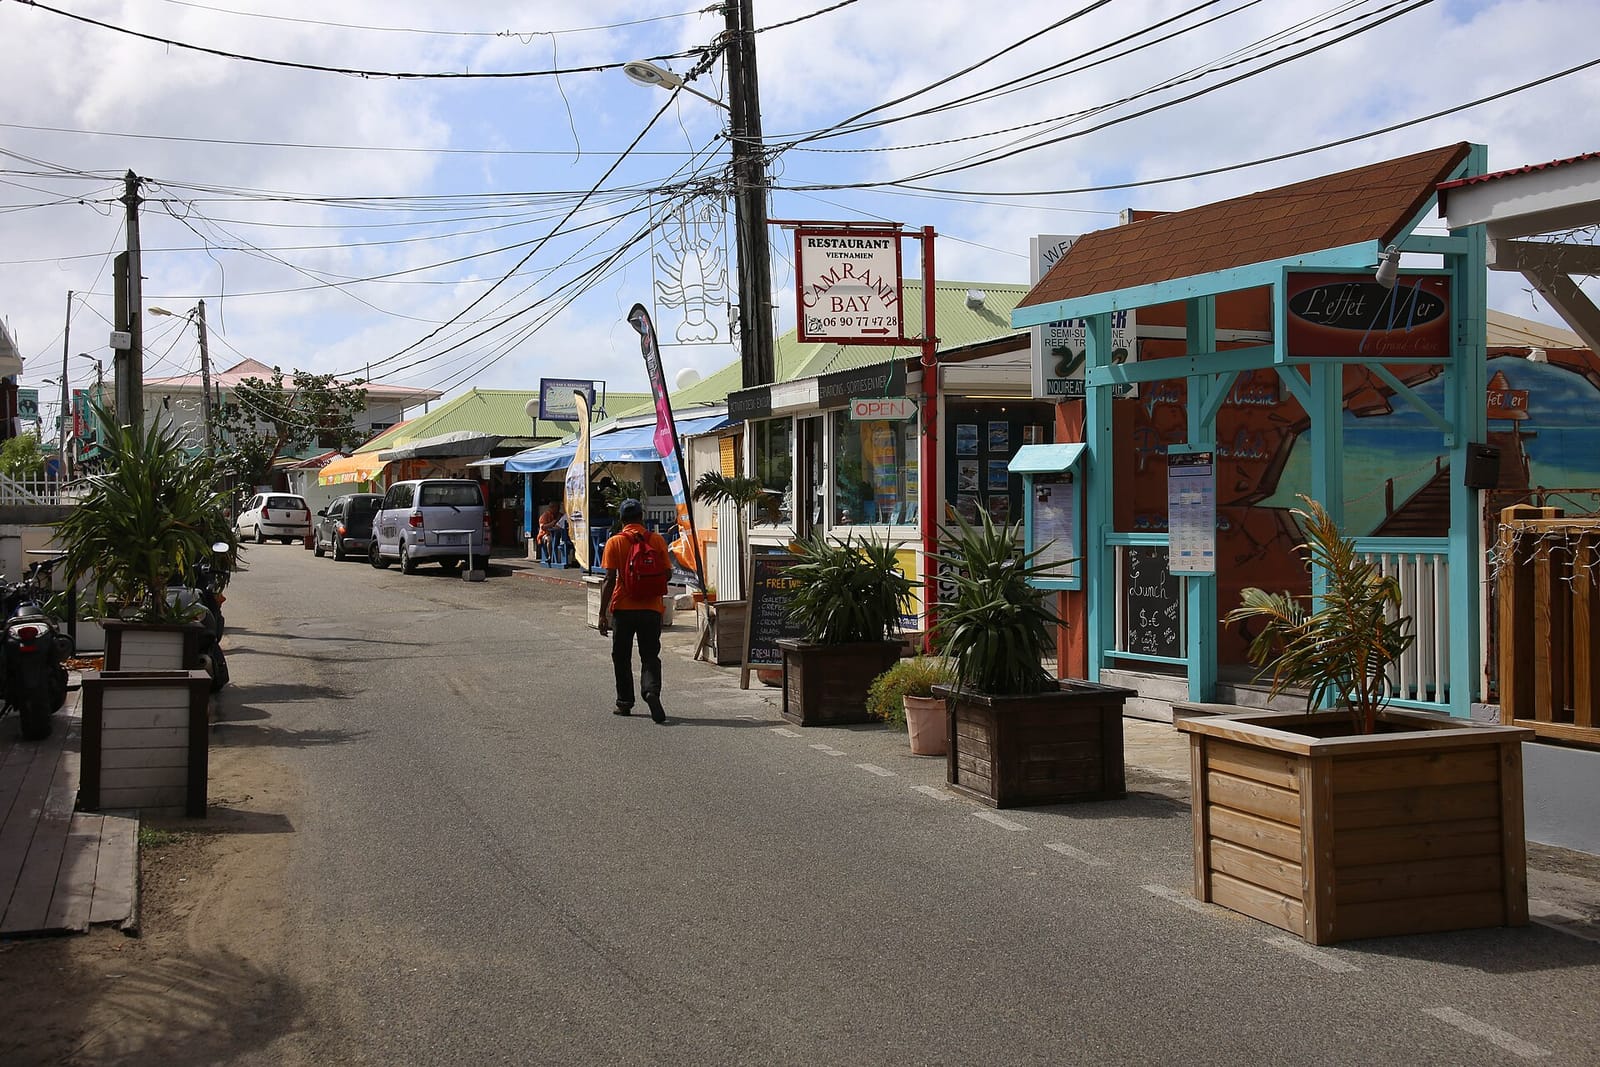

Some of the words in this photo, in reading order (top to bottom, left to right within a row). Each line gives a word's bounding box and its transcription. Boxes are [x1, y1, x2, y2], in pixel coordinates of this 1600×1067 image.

[808, 238, 890, 249] RESTAURANT
[802, 262, 898, 309] CAMRANH
[831, 295, 872, 313] BAY
[823, 317, 837, 327] 06
[840, 316, 853, 327] 90
[856, 316, 868, 326] 77
[886, 316, 897, 326] 28
[1044, 338, 1069, 347] REEF
[855, 402, 906, 416] OPEN
[766, 578, 786, 589] FREE
[1129, 570, 1168, 599] Lunch
